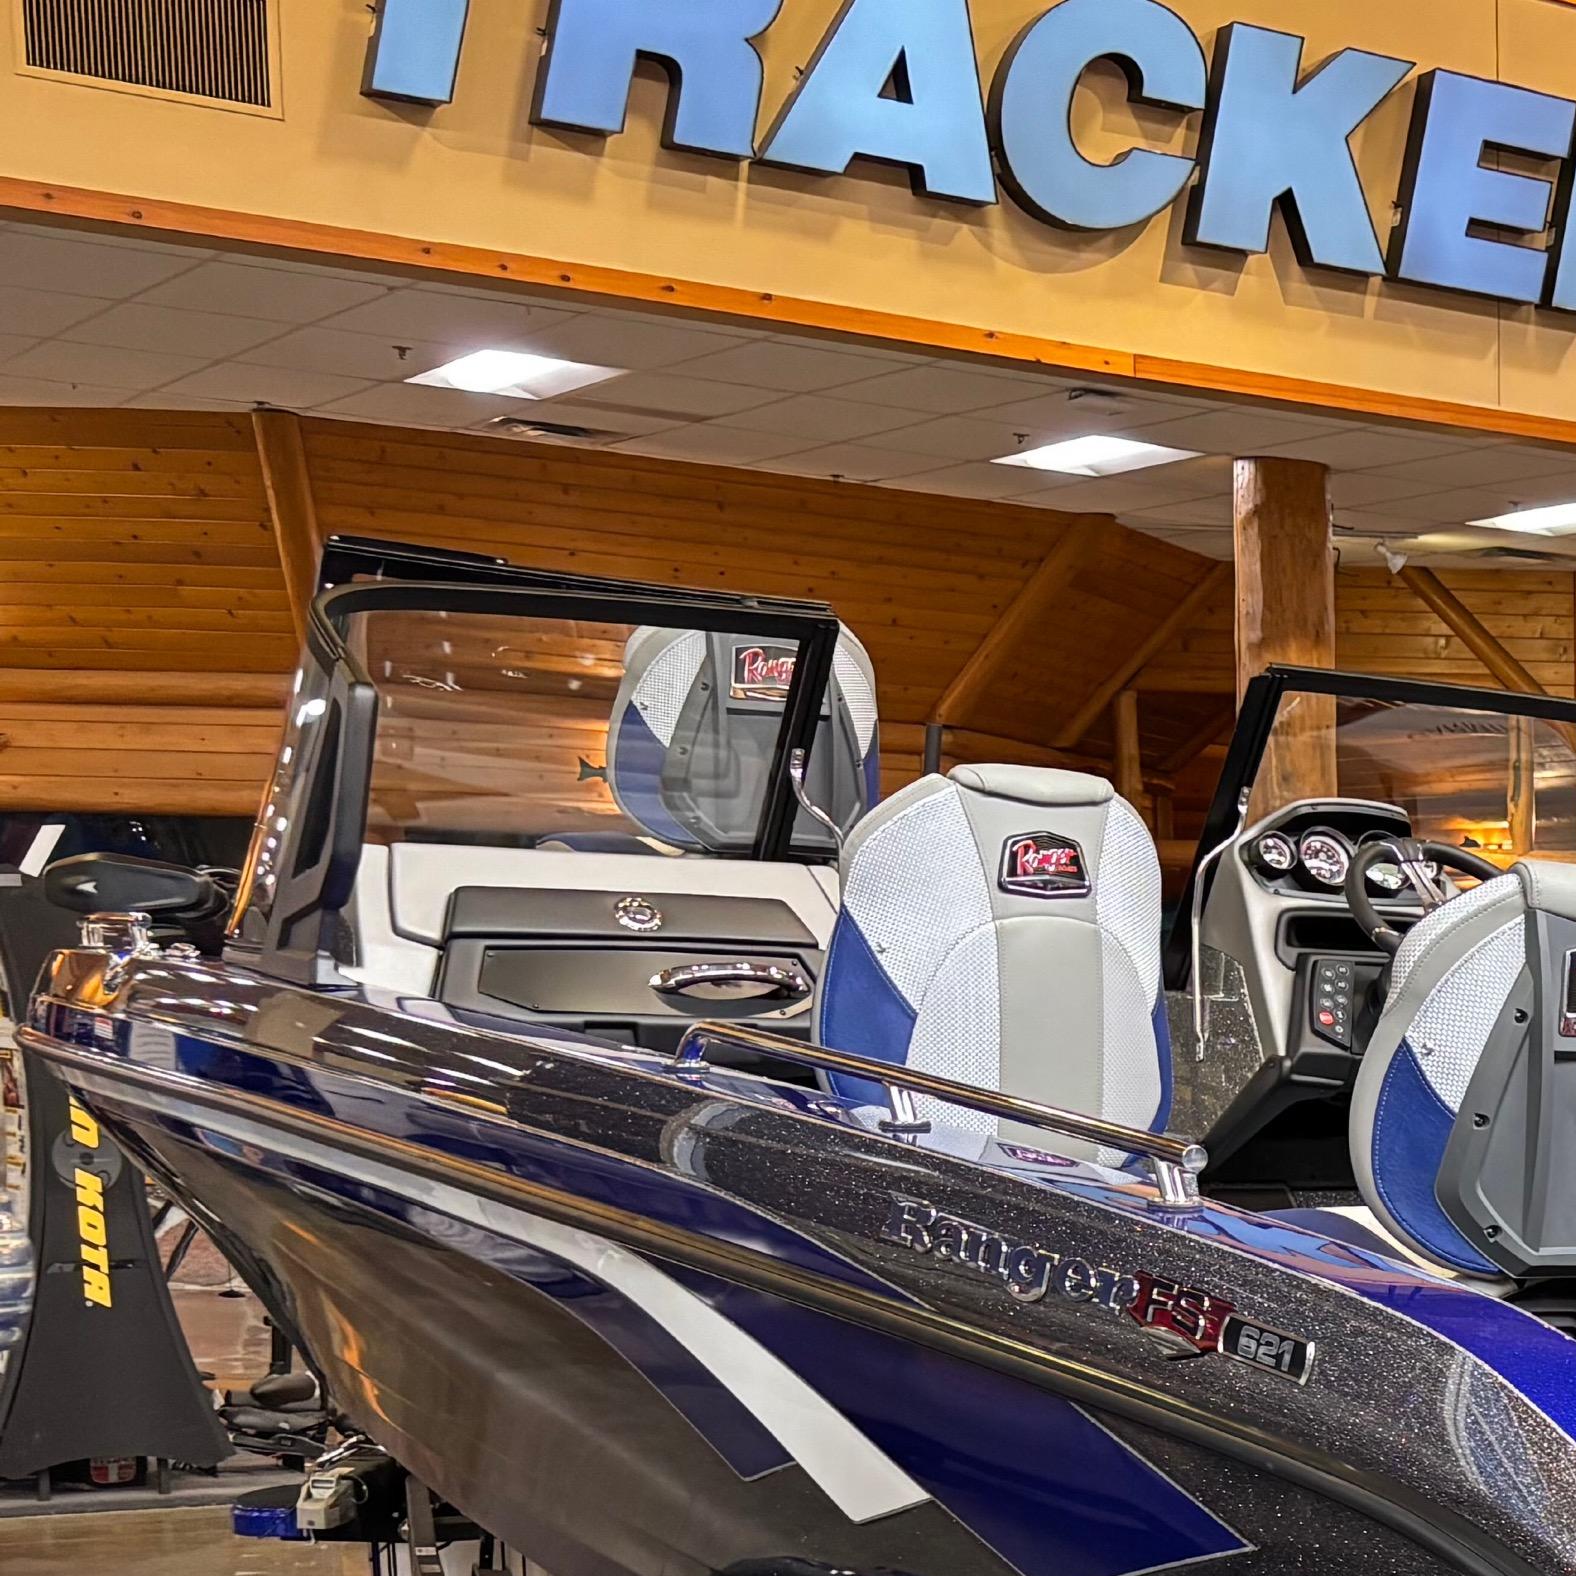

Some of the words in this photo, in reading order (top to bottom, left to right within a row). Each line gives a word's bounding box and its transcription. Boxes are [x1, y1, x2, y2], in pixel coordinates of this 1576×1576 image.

[73, 1167, 113, 1309] KOTA
[879, 1198, 1140, 1317] Ranger
[1145, 1272, 1212, 1342] FS
[1235, 1324, 1297, 1374] 621
